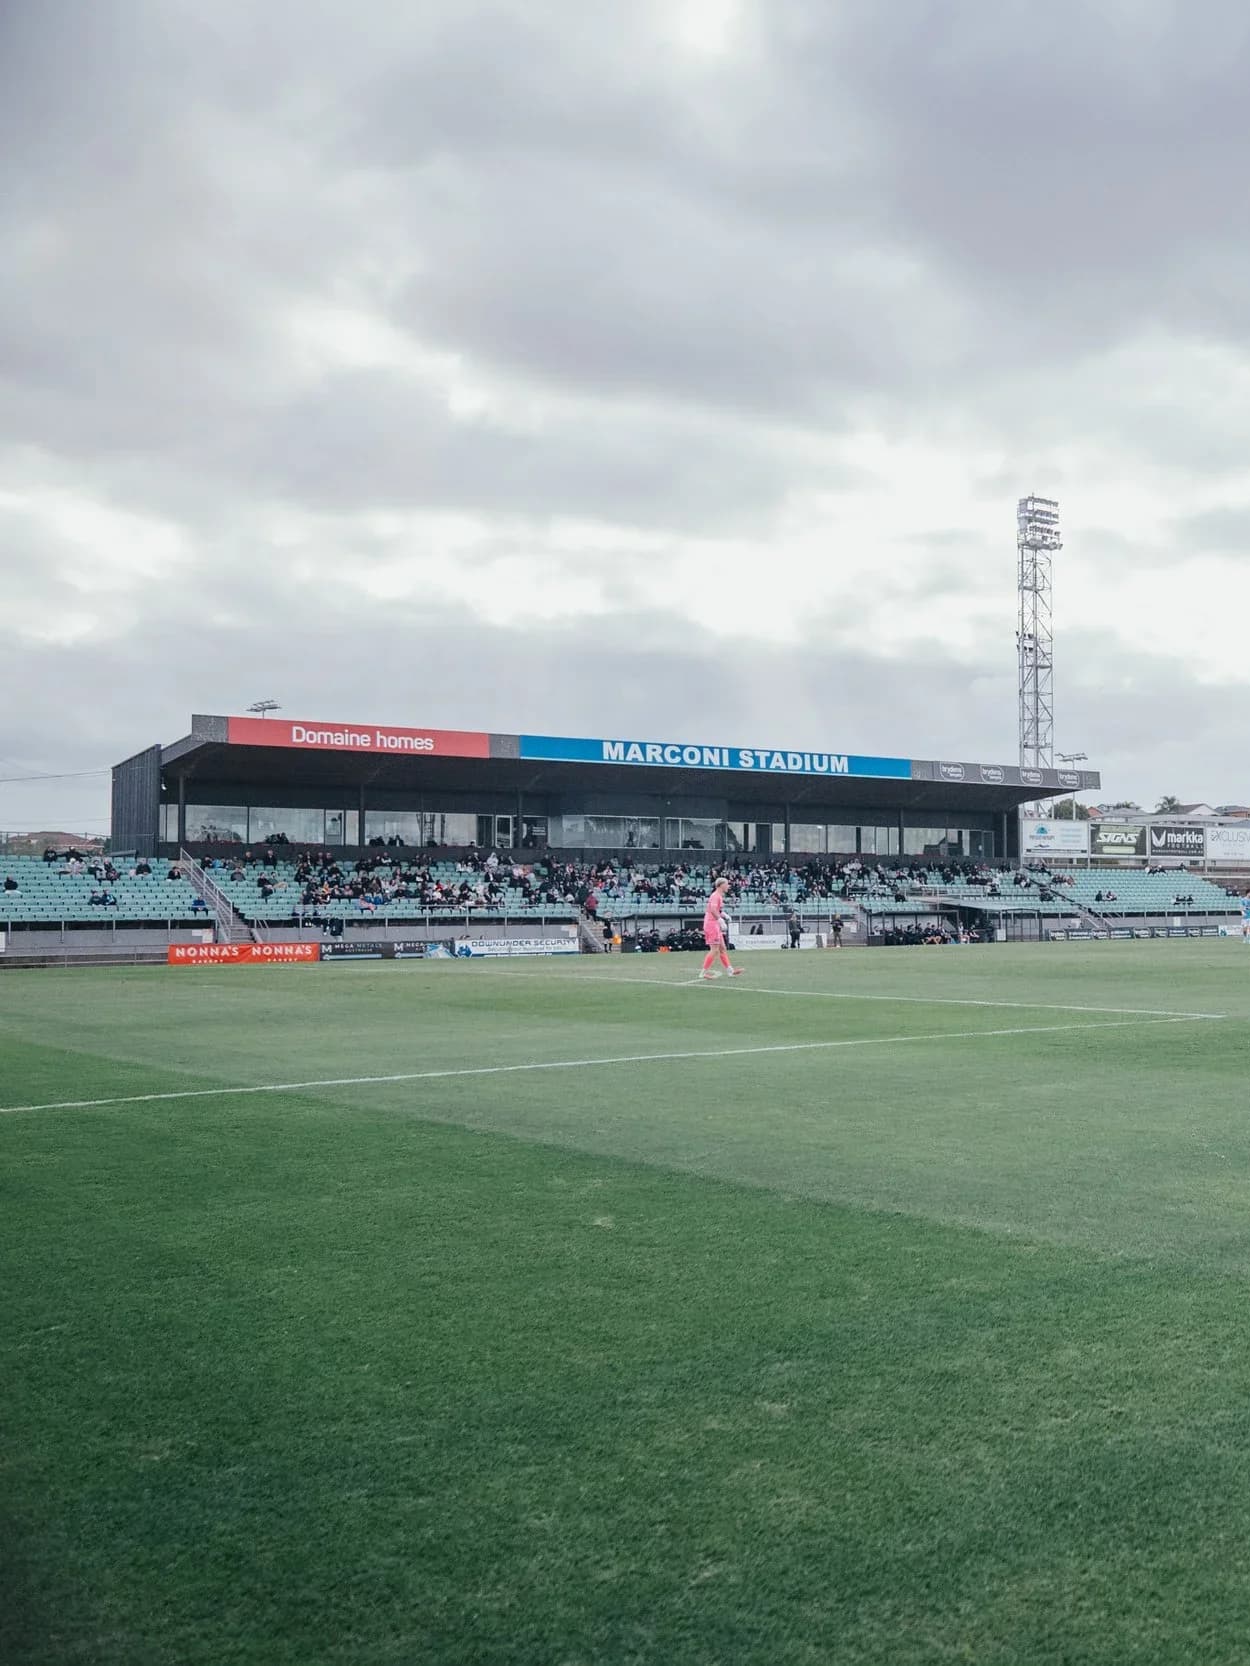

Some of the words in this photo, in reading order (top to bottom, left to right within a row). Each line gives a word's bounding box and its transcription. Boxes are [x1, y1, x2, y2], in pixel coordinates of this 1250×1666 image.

[292, 726, 371, 747] Domaine
[376, 731, 434, 751] homes
[602, 741, 730, 766] MARCONI
[739, 750, 849, 773] STADIUM
[1097, 832, 1139, 844] SIGNS
[1167, 831, 1203, 844] markka
[175, 947, 239, 957] NONNA'S
[251, 945, 313, 956] NONNA'S
